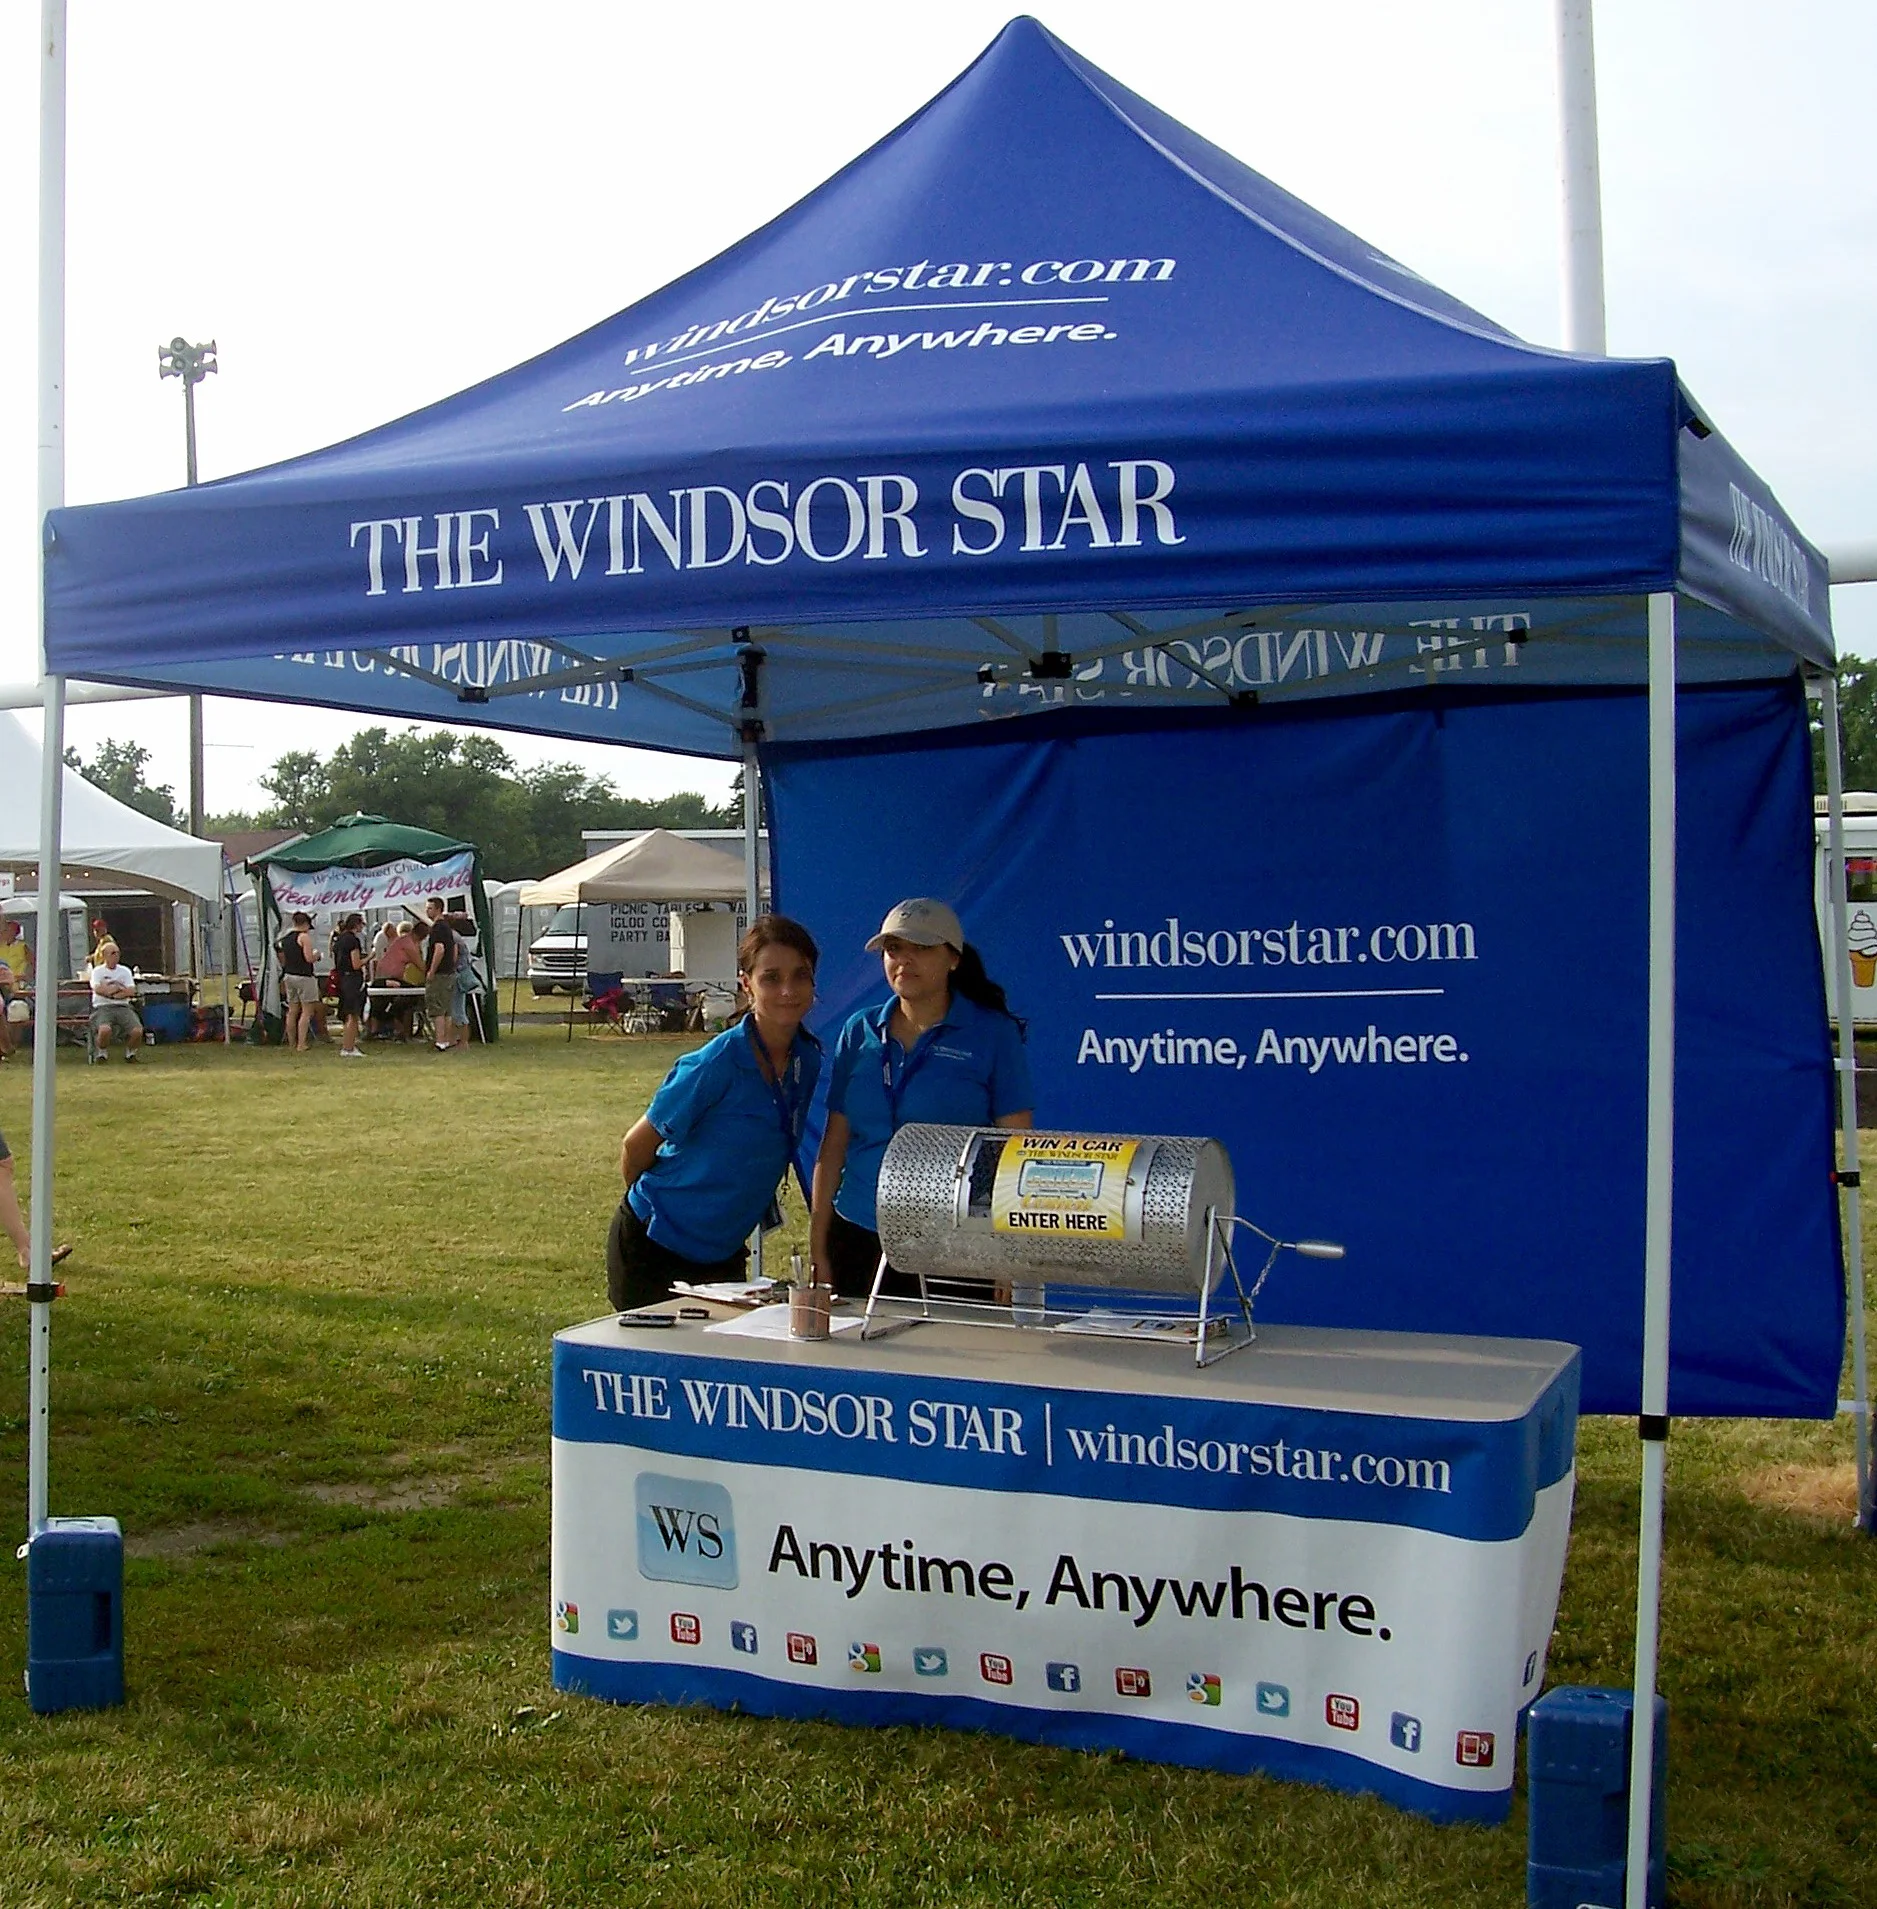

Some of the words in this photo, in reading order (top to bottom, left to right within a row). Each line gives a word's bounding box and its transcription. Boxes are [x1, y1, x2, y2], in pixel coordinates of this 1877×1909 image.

[624, 256, 1177, 367] windsorstar.com
[562, 347, 793, 412] Anytime,
[803, 319, 1119, 360] Anywhere.
[350, 508, 502, 596] THE
[522, 474, 928, 583] WINDSOR
[951, 458, 1186, 557] STAR
[271, 880, 374, 909] Heavenly
[384, 867, 473, 899] Desserts
[610, 902, 648, 915] PICNIC
[610, 916, 645, 929] IGLOO
[610, 930, 649, 943] PARTY
[1060, 917, 1479, 968] windsorstar.com
[1077, 1028, 1248, 1073] Anytime,
[1254, 1025, 1470, 1074] Anywhere.
[1023, 1138, 1060, 1150] WIN
[1063, 1140, 1077, 1151] A
[1082, 1140, 1123, 1152] CAR
[1009, 1212, 1060, 1229] ENTER
[1065, 1213, 1108, 1230] HERE
[582, 1368, 672, 1420] THE
[680, 1378, 898, 1442] WINDSOR
[908, 1399, 1027, 1457] STAR
[1065, 1423, 1452, 1494] windsorstar.com
[649, 1503, 725, 1560] WS
[767, 1523, 1031, 1612] Anytime,
[1044, 1553, 1393, 1642] Anywhere.
[1331, 1710, 1356, 1728] Tube
[1333, 1698, 1352, 1713] You
